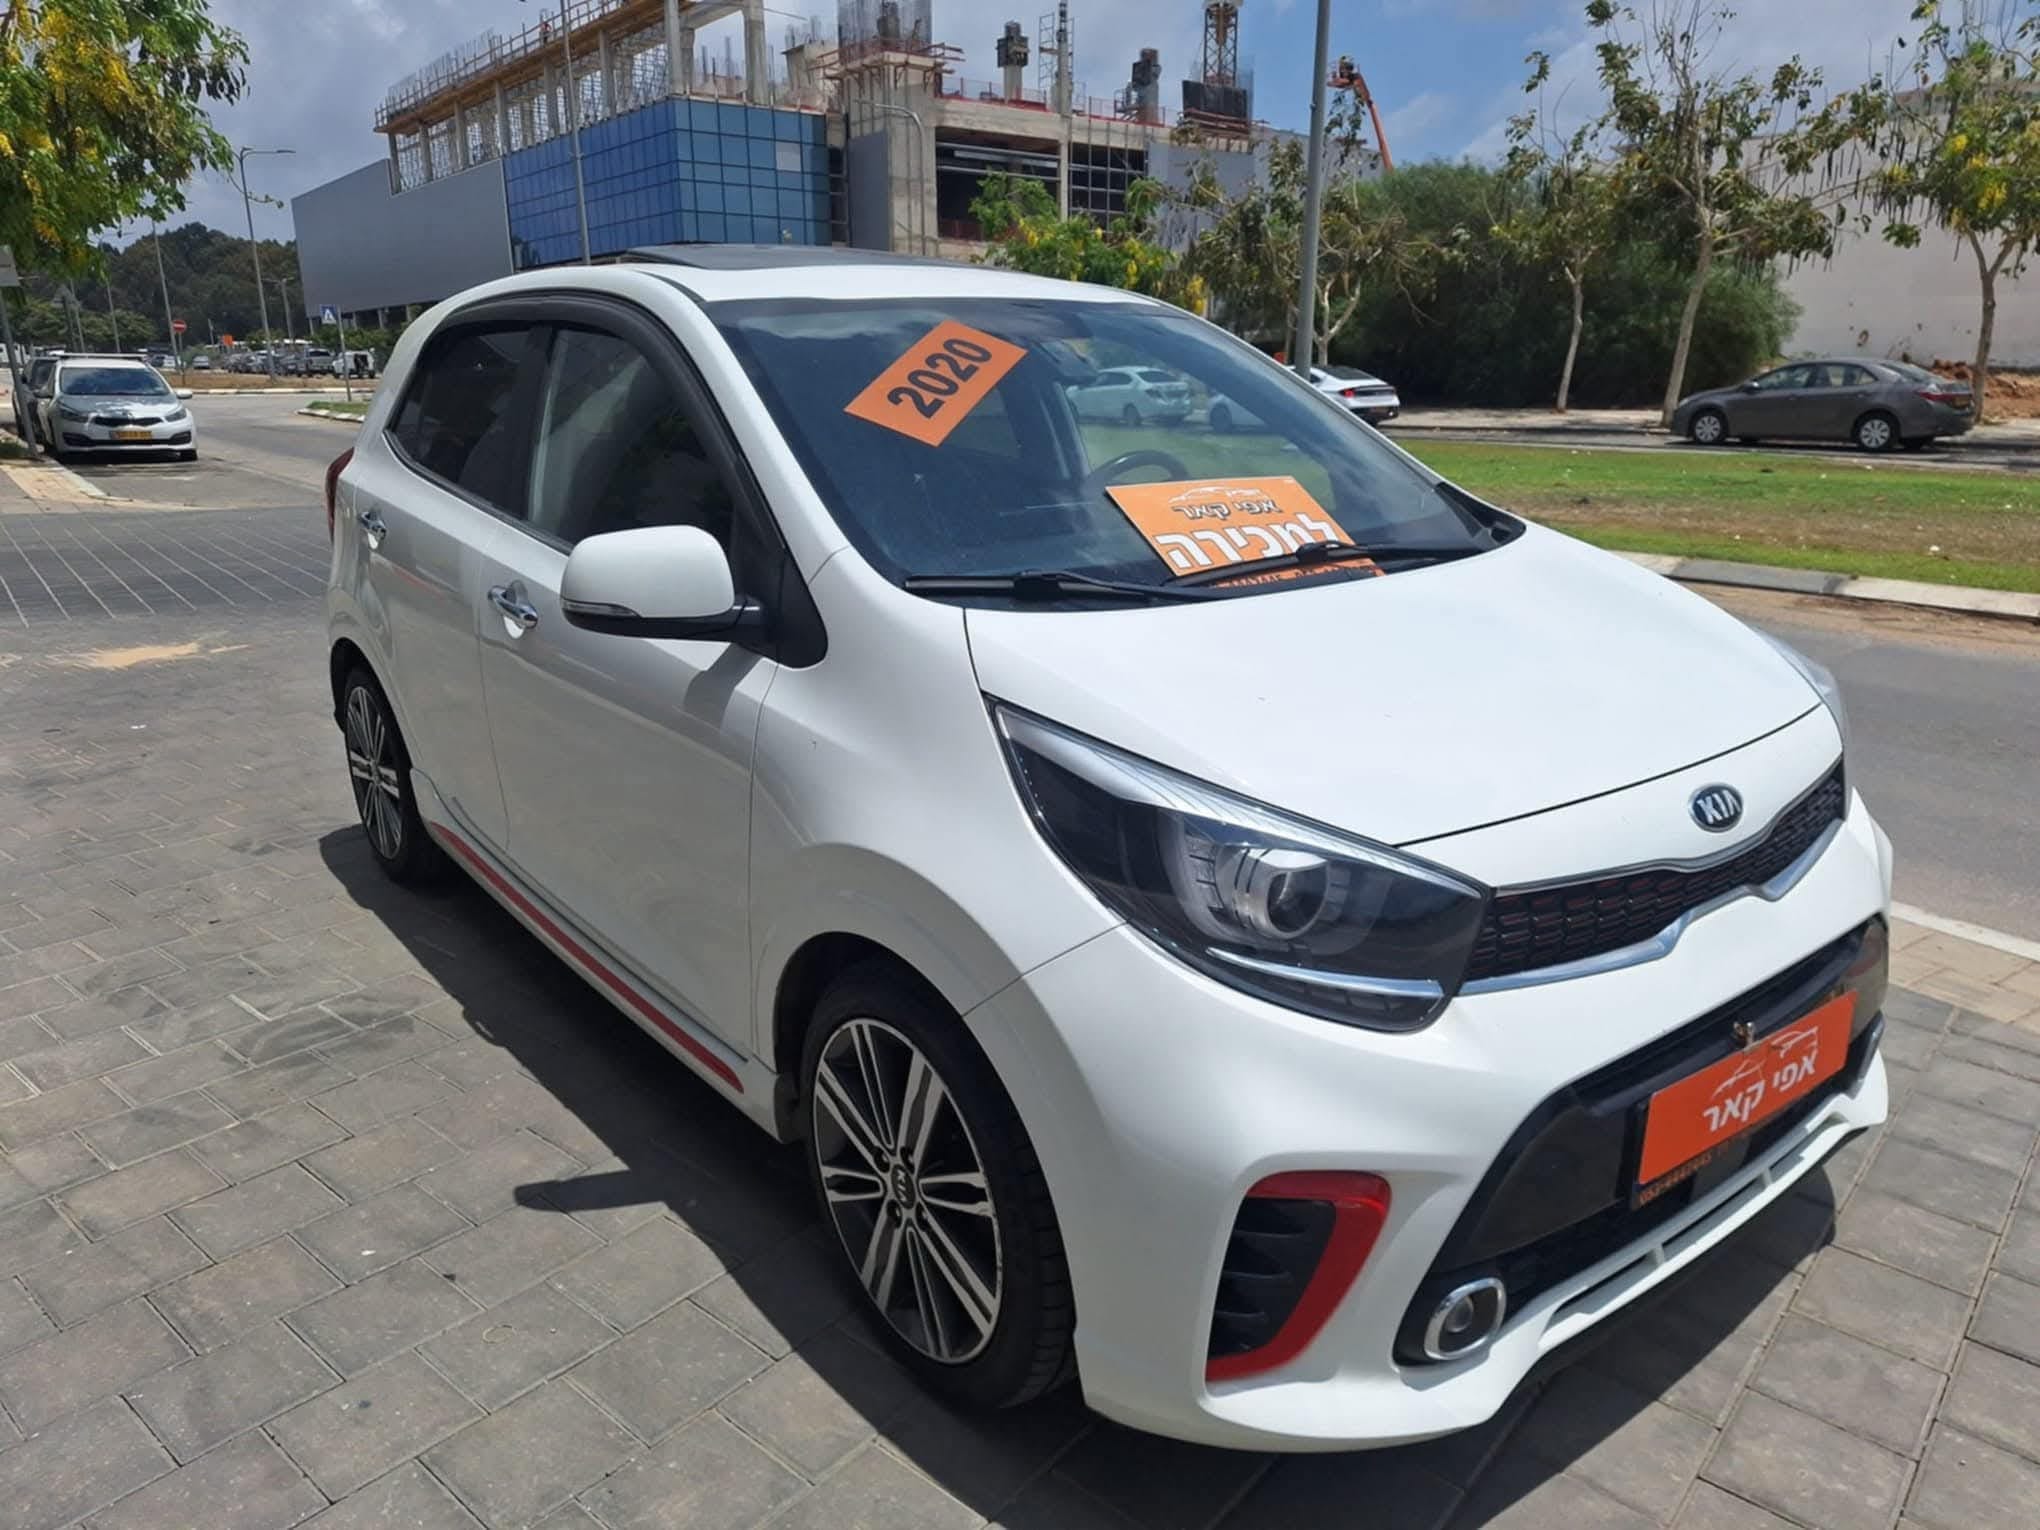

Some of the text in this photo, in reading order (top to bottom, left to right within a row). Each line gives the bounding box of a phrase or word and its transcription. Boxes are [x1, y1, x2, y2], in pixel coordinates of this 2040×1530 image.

[887, 338, 993, 419] 2020
[1172, 498, 1283, 521] אפי קאר
[1155, 513, 1339, 569] למכירה
[1697, 790, 1741, 824] KIA
[1703, 1053, 1817, 1132] אפי קאר
[897, 1169, 907, 1203] KIA
